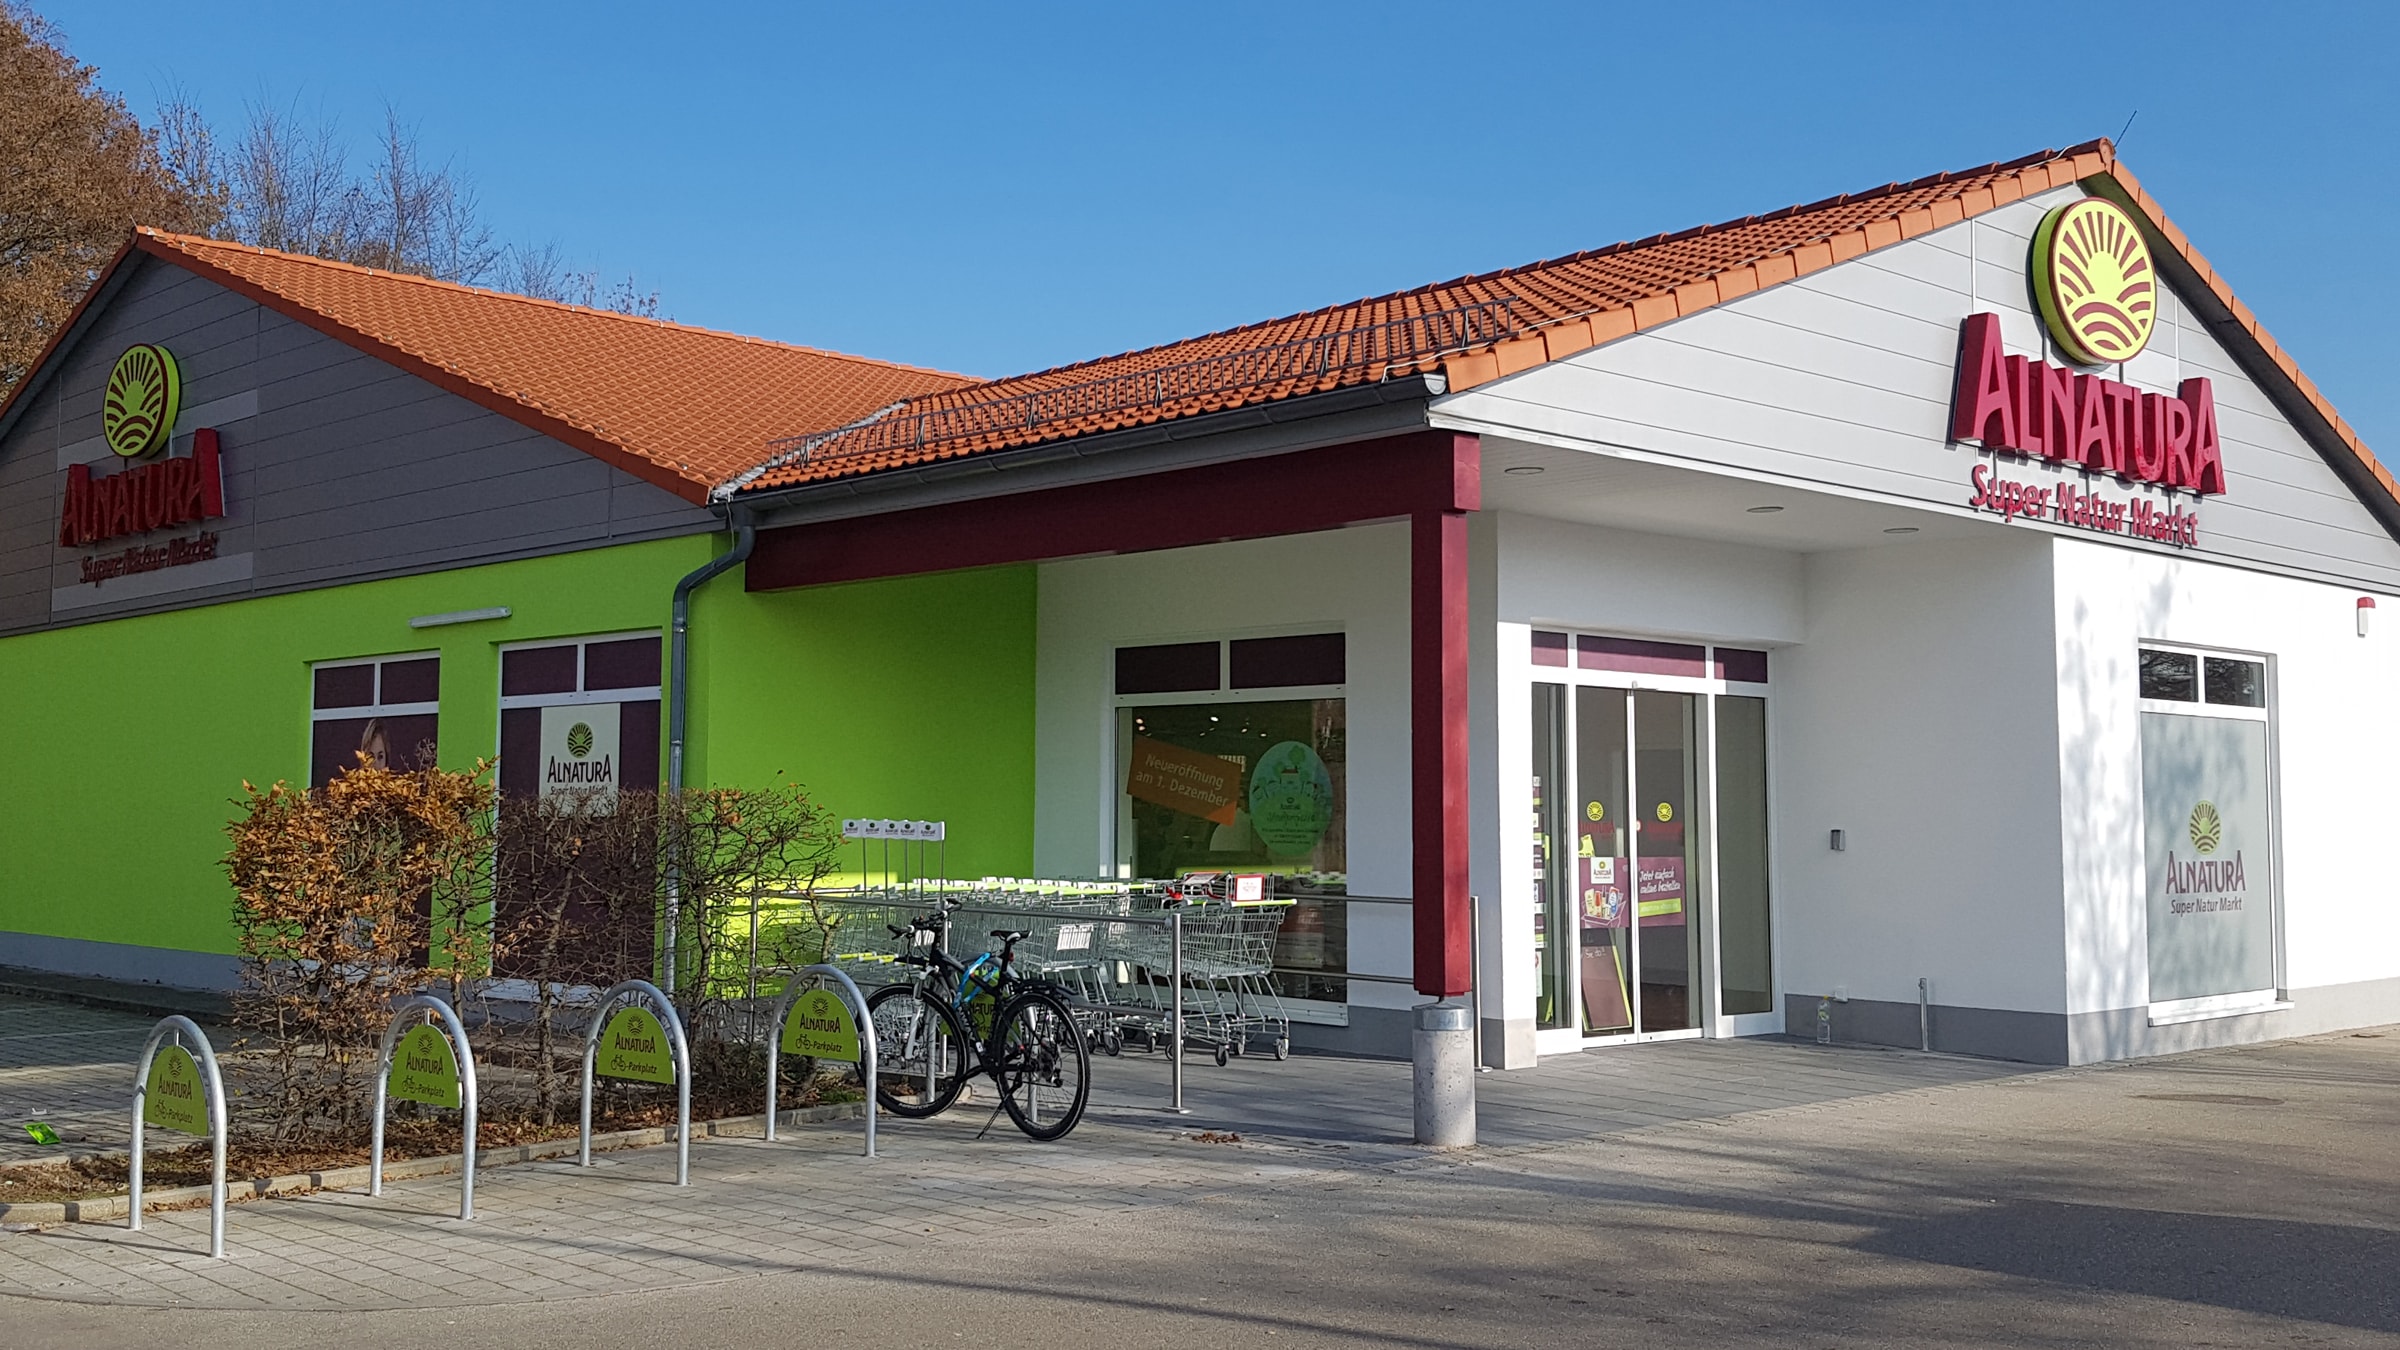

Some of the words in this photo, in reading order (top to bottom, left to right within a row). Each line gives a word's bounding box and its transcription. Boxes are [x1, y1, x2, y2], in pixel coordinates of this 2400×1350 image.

[1951, 312, 2227, 496] ALNATURA
[59, 428, 225, 547] ALNATURA
[1969, 464, 2052, 523] Super
[2055, 481, 2127, 532] Natur
[2129, 497, 2199, 546] Markt
[79, 555, 124, 588] Super
[547, 754, 612, 783] ALNATURA
[1145, 753, 1224, 790] Neueröffnung
[1136, 771, 1153, 784] am
[1157, 775, 1165, 789] 1.
[1169, 779, 1228, 807] Dezember
[2166, 850, 2246, 894] ALNATURA
[2171, 899, 2195, 918] Super
[2196, 898, 2218, 912] Natur
[2219, 896, 2242, 911] Markt
[800, 1013, 841, 1033] ALNATURA
[614, 1032, 656, 1054] ALNATURA
[406, 1051, 444, 1076] ALNATURA
[157, 1073, 193, 1100] ALNATURA
